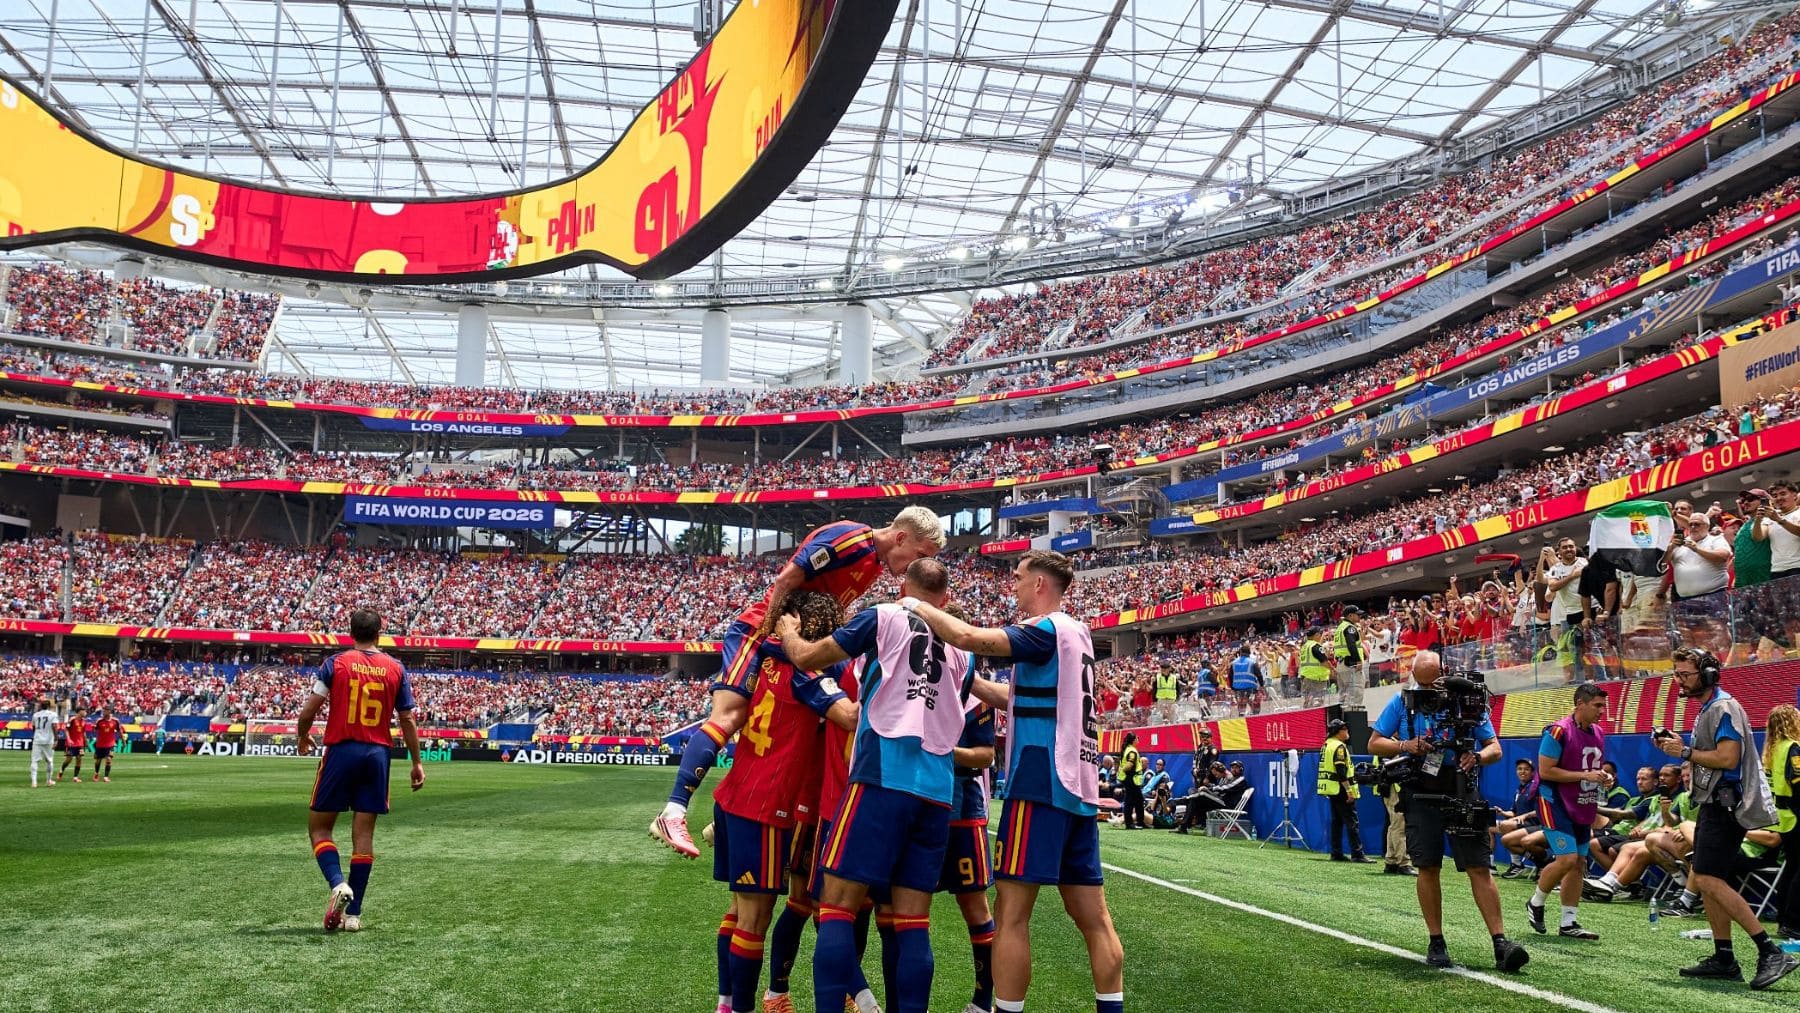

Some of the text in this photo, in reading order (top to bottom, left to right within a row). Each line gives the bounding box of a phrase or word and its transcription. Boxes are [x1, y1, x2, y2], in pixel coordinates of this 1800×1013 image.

[1468, 344, 1580, 400] LOS ANGELES
[458, 414, 488, 422] GOAL
[412, 422, 522, 435] LOS ANGELES
[1435, 435, 1466, 454] GOAL
[1702, 435, 1768, 472] GOAL
[1320, 476, 1346, 492] GOAL
[424, 489, 456, 498] GOAL
[356, 502, 544, 521] FIFA WORLD CUP 2026
[1218, 506, 1246, 519] GOAL
[1162, 604, 1184, 615] GOAL
[1090, 618, 1104, 628] OAL
[404, 638, 440, 647] GOAL
[593, 642, 627, 650] GOAL
[348, 678, 384, 726] 16
[37, 716, 48, 730] 17
[1266, 721, 1290, 742] GOAL
[197, 742, 238, 756] ADI
[514, 750, 670, 766] ADI PREDICTSTREET
[1080, 748, 1098, 766] 202
[958, 857, 975, 886] 9
